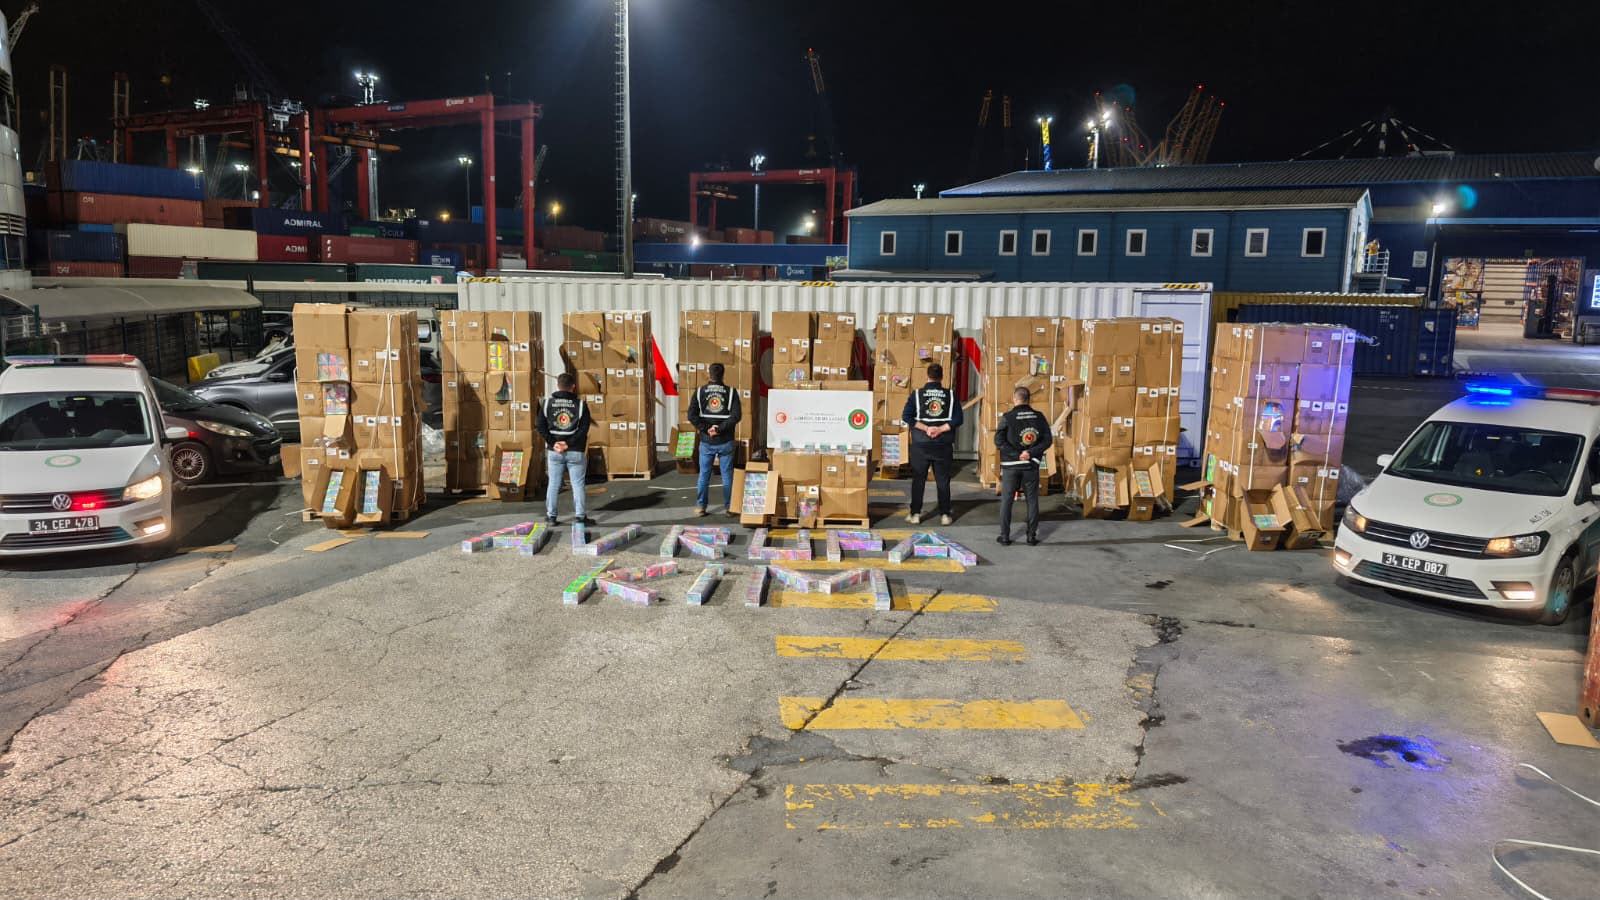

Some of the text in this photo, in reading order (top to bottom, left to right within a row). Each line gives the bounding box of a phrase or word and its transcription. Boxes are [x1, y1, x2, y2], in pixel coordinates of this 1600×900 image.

[284, 218, 323, 228] ADMIRAL
[35, 521, 48, 531] 34
[52, 519, 71, 530] CEP
[1385, 554, 1444, 574] 34 CEP 087
